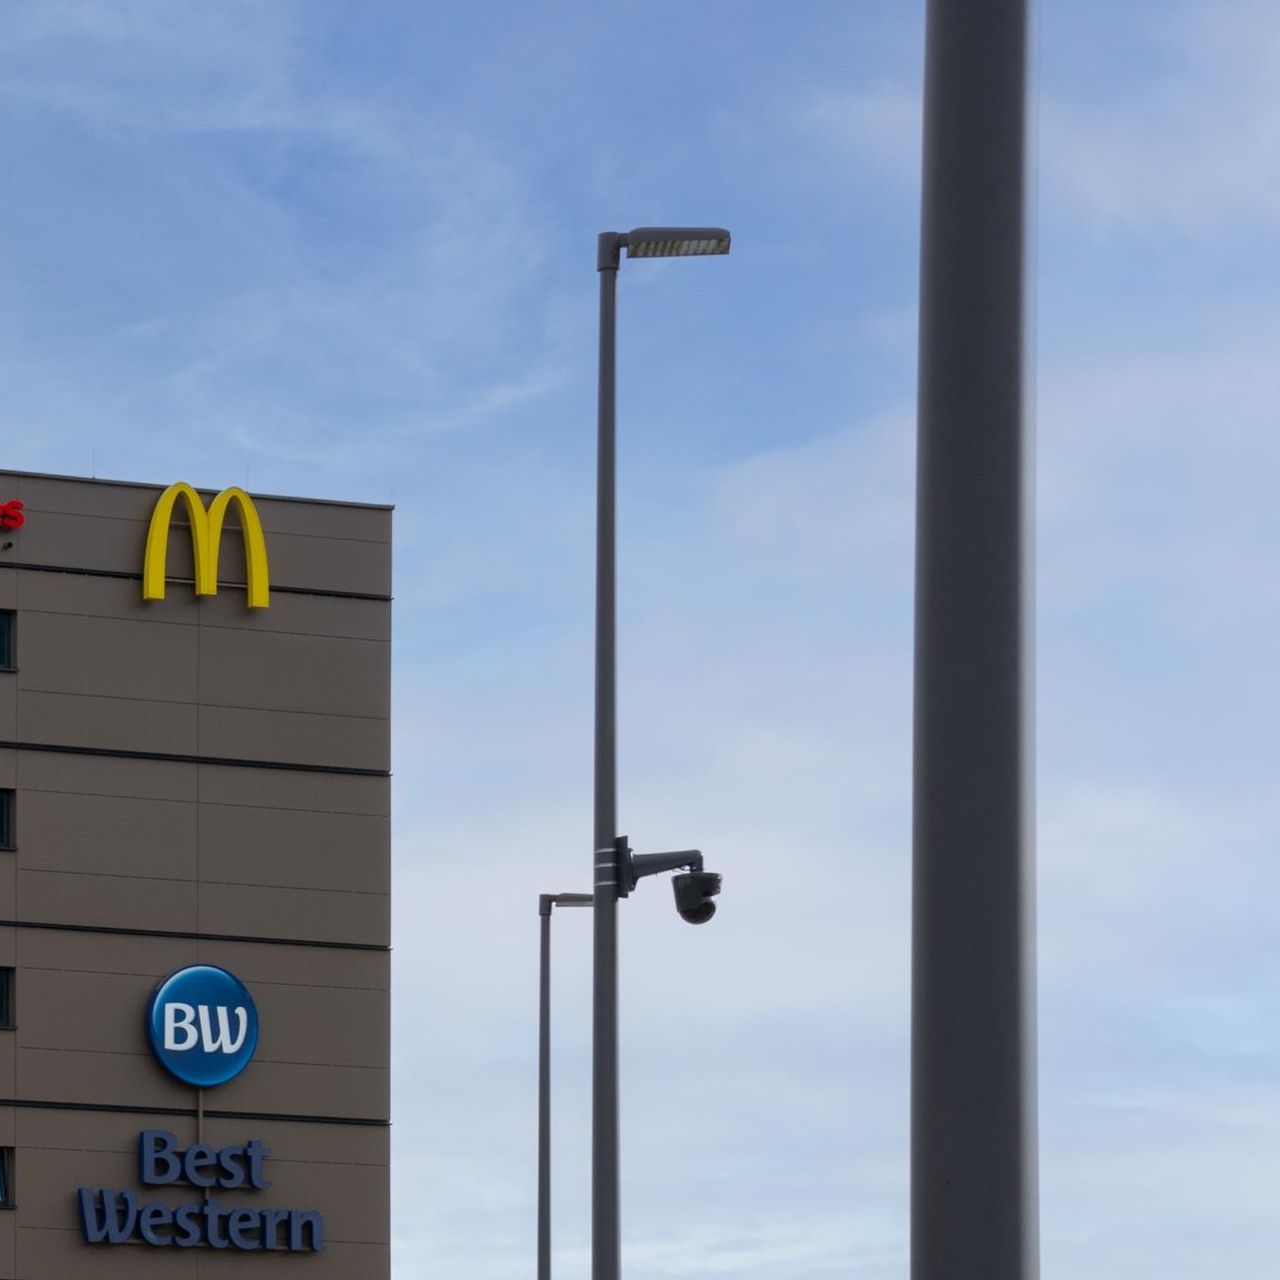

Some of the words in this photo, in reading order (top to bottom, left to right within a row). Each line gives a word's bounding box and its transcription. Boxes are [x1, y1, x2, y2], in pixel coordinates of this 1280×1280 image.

[163, 1001, 248, 1055] BW
[138, 1129, 272, 1190] Best
[77, 1187, 327, 1253] Western
